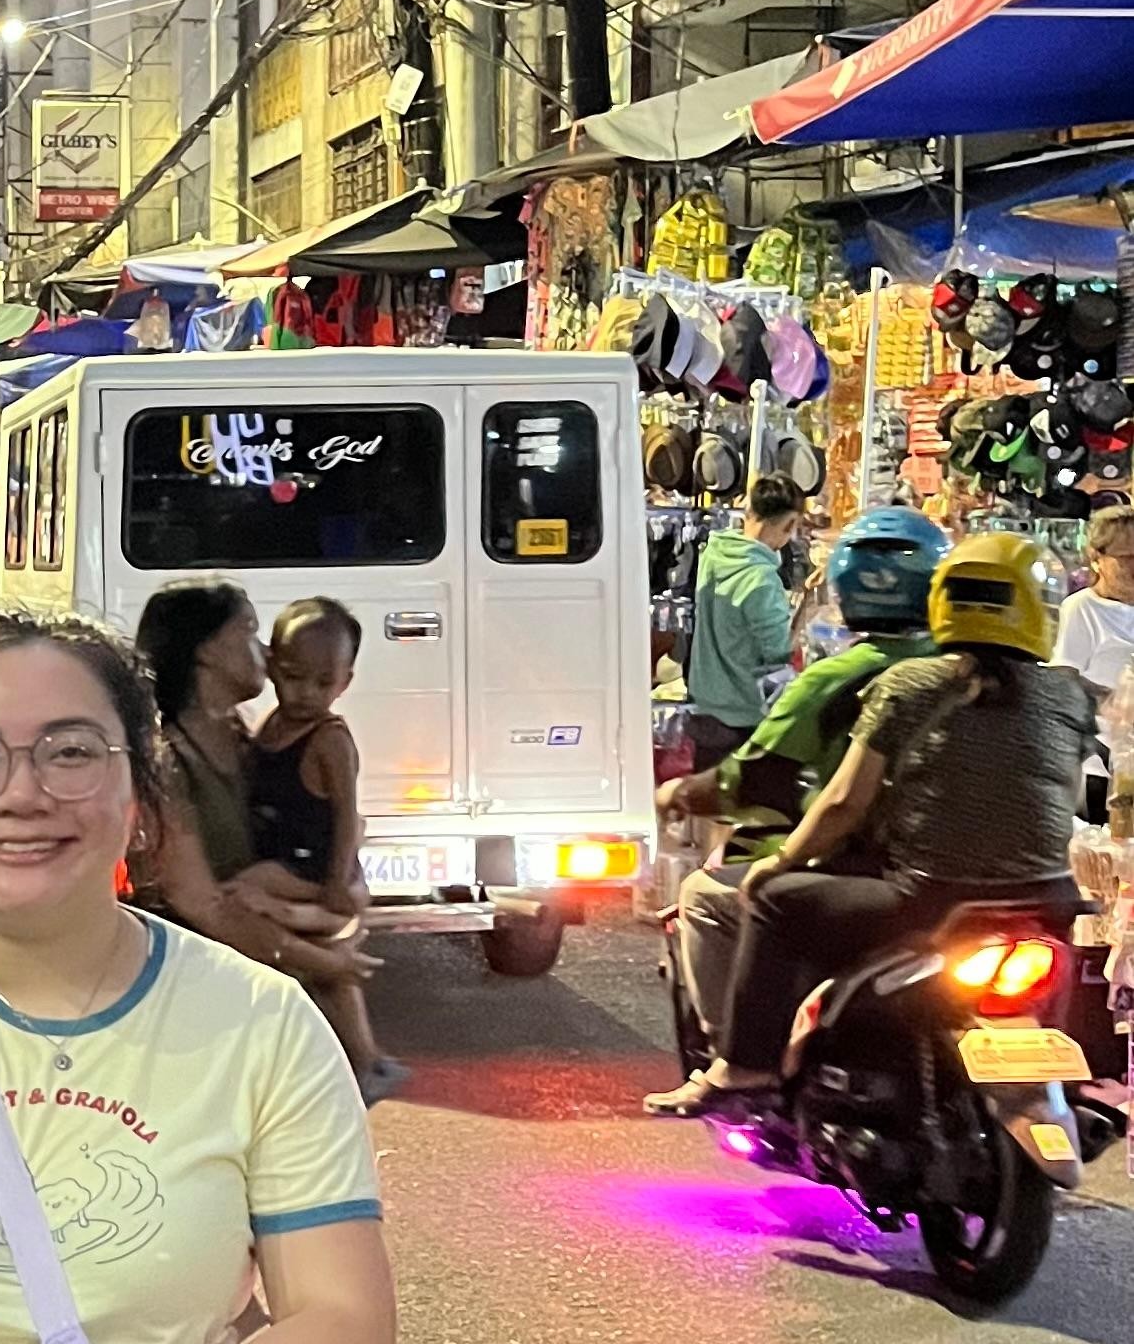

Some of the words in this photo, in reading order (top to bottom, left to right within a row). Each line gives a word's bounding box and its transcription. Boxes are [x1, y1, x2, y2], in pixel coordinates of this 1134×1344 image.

[308, 435, 383, 470] God
[28, 1087, 46, 1105] &
[55, 1087, 159, 1144] GRANOLA
